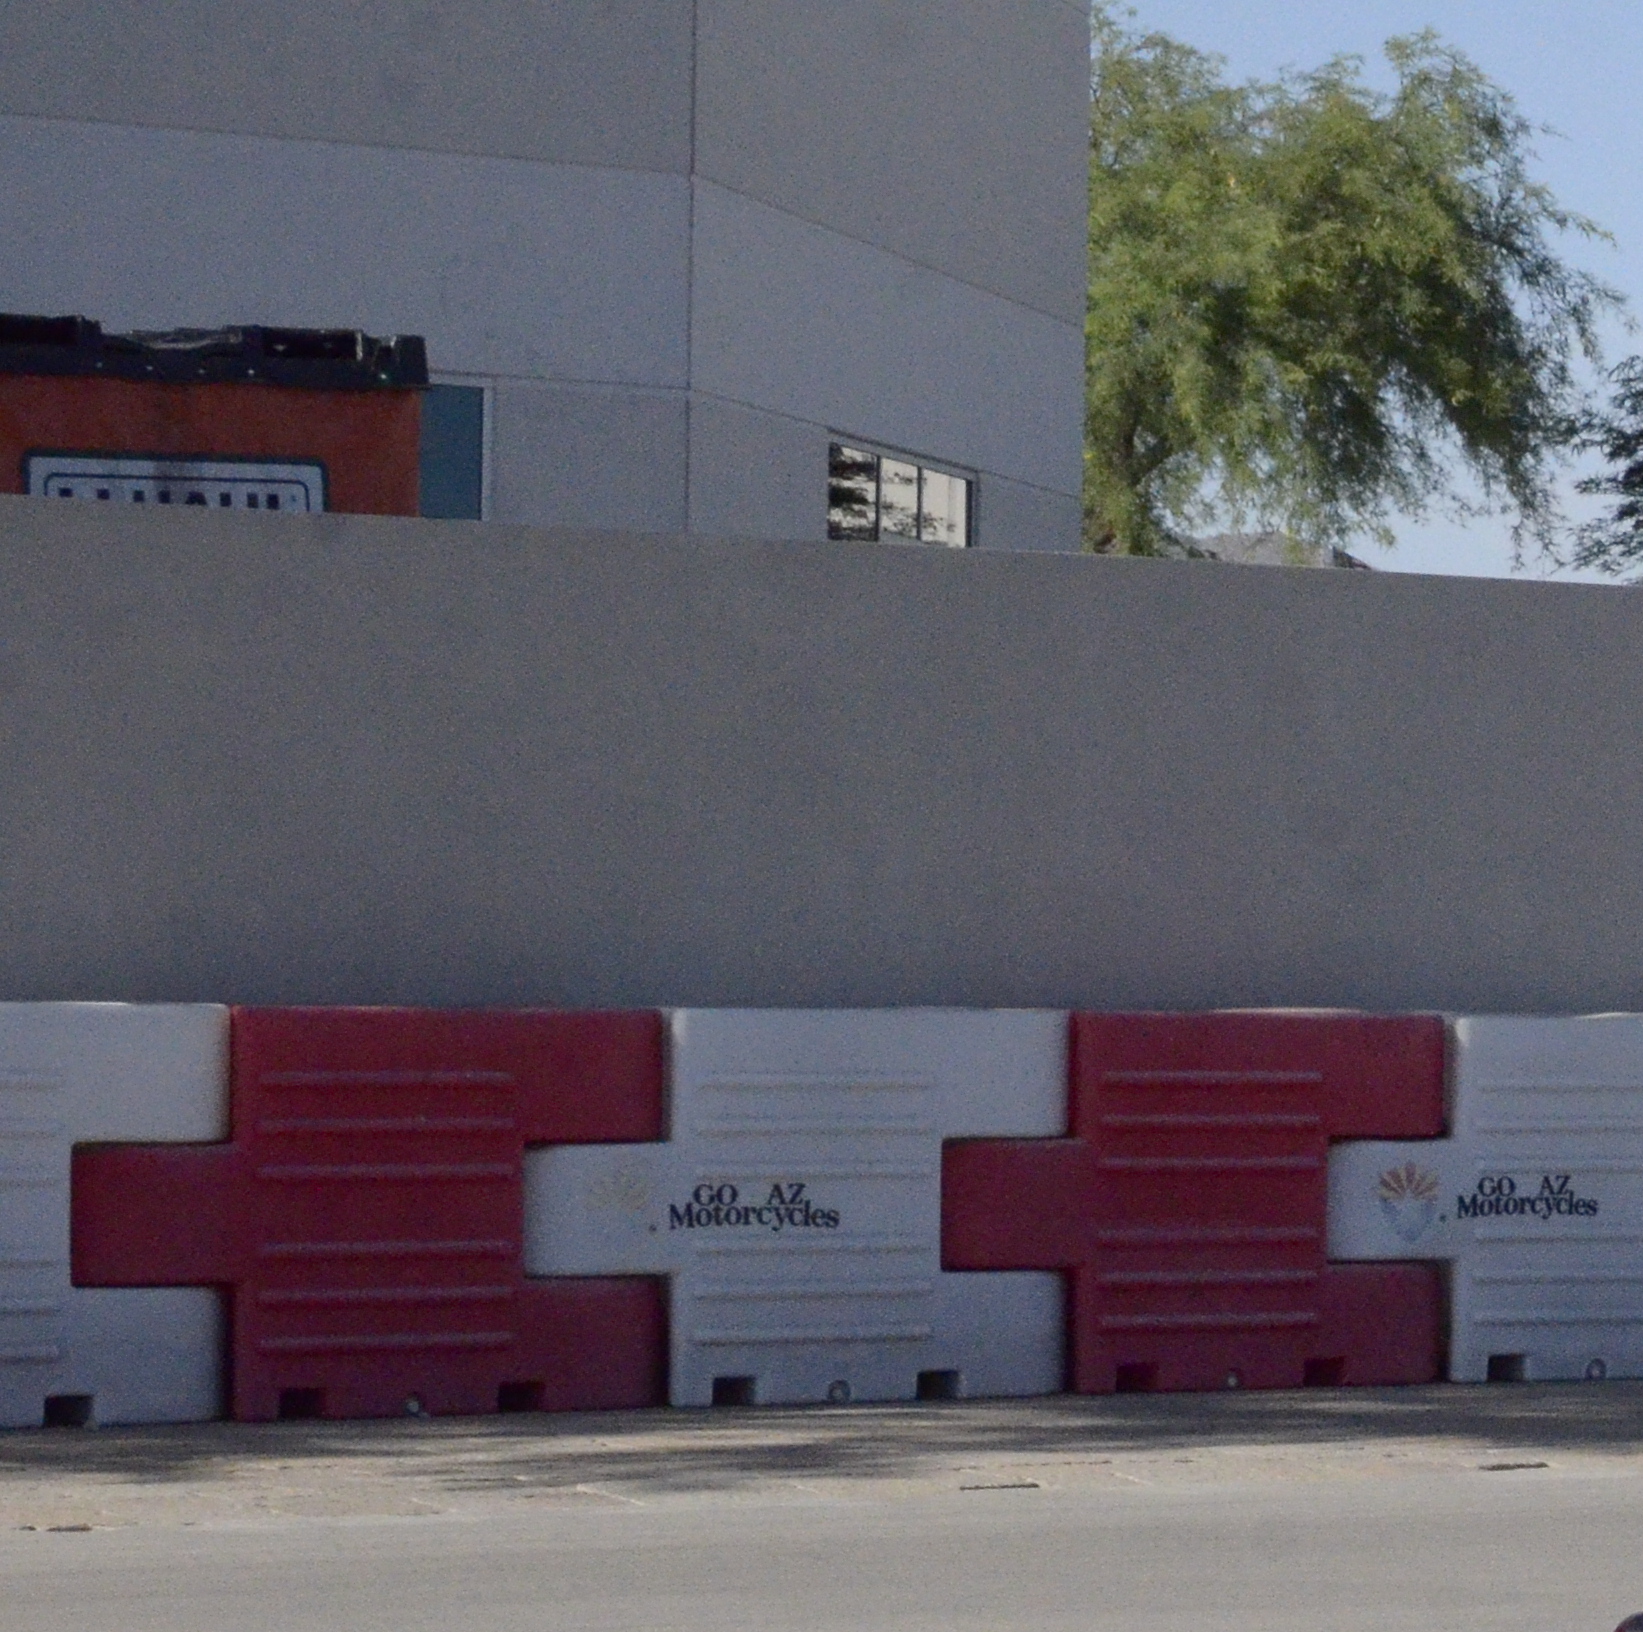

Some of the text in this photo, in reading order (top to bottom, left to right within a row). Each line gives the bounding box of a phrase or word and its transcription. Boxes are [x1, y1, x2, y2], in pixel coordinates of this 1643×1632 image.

[693, 1182, 807, 1206] GO AZ
[1477, 1175, 1572, 1198] GO AZ
[669, 1201, 840, 1232] Motorcycles
[1457, 1195, 1598, 1220] Motorcycles
